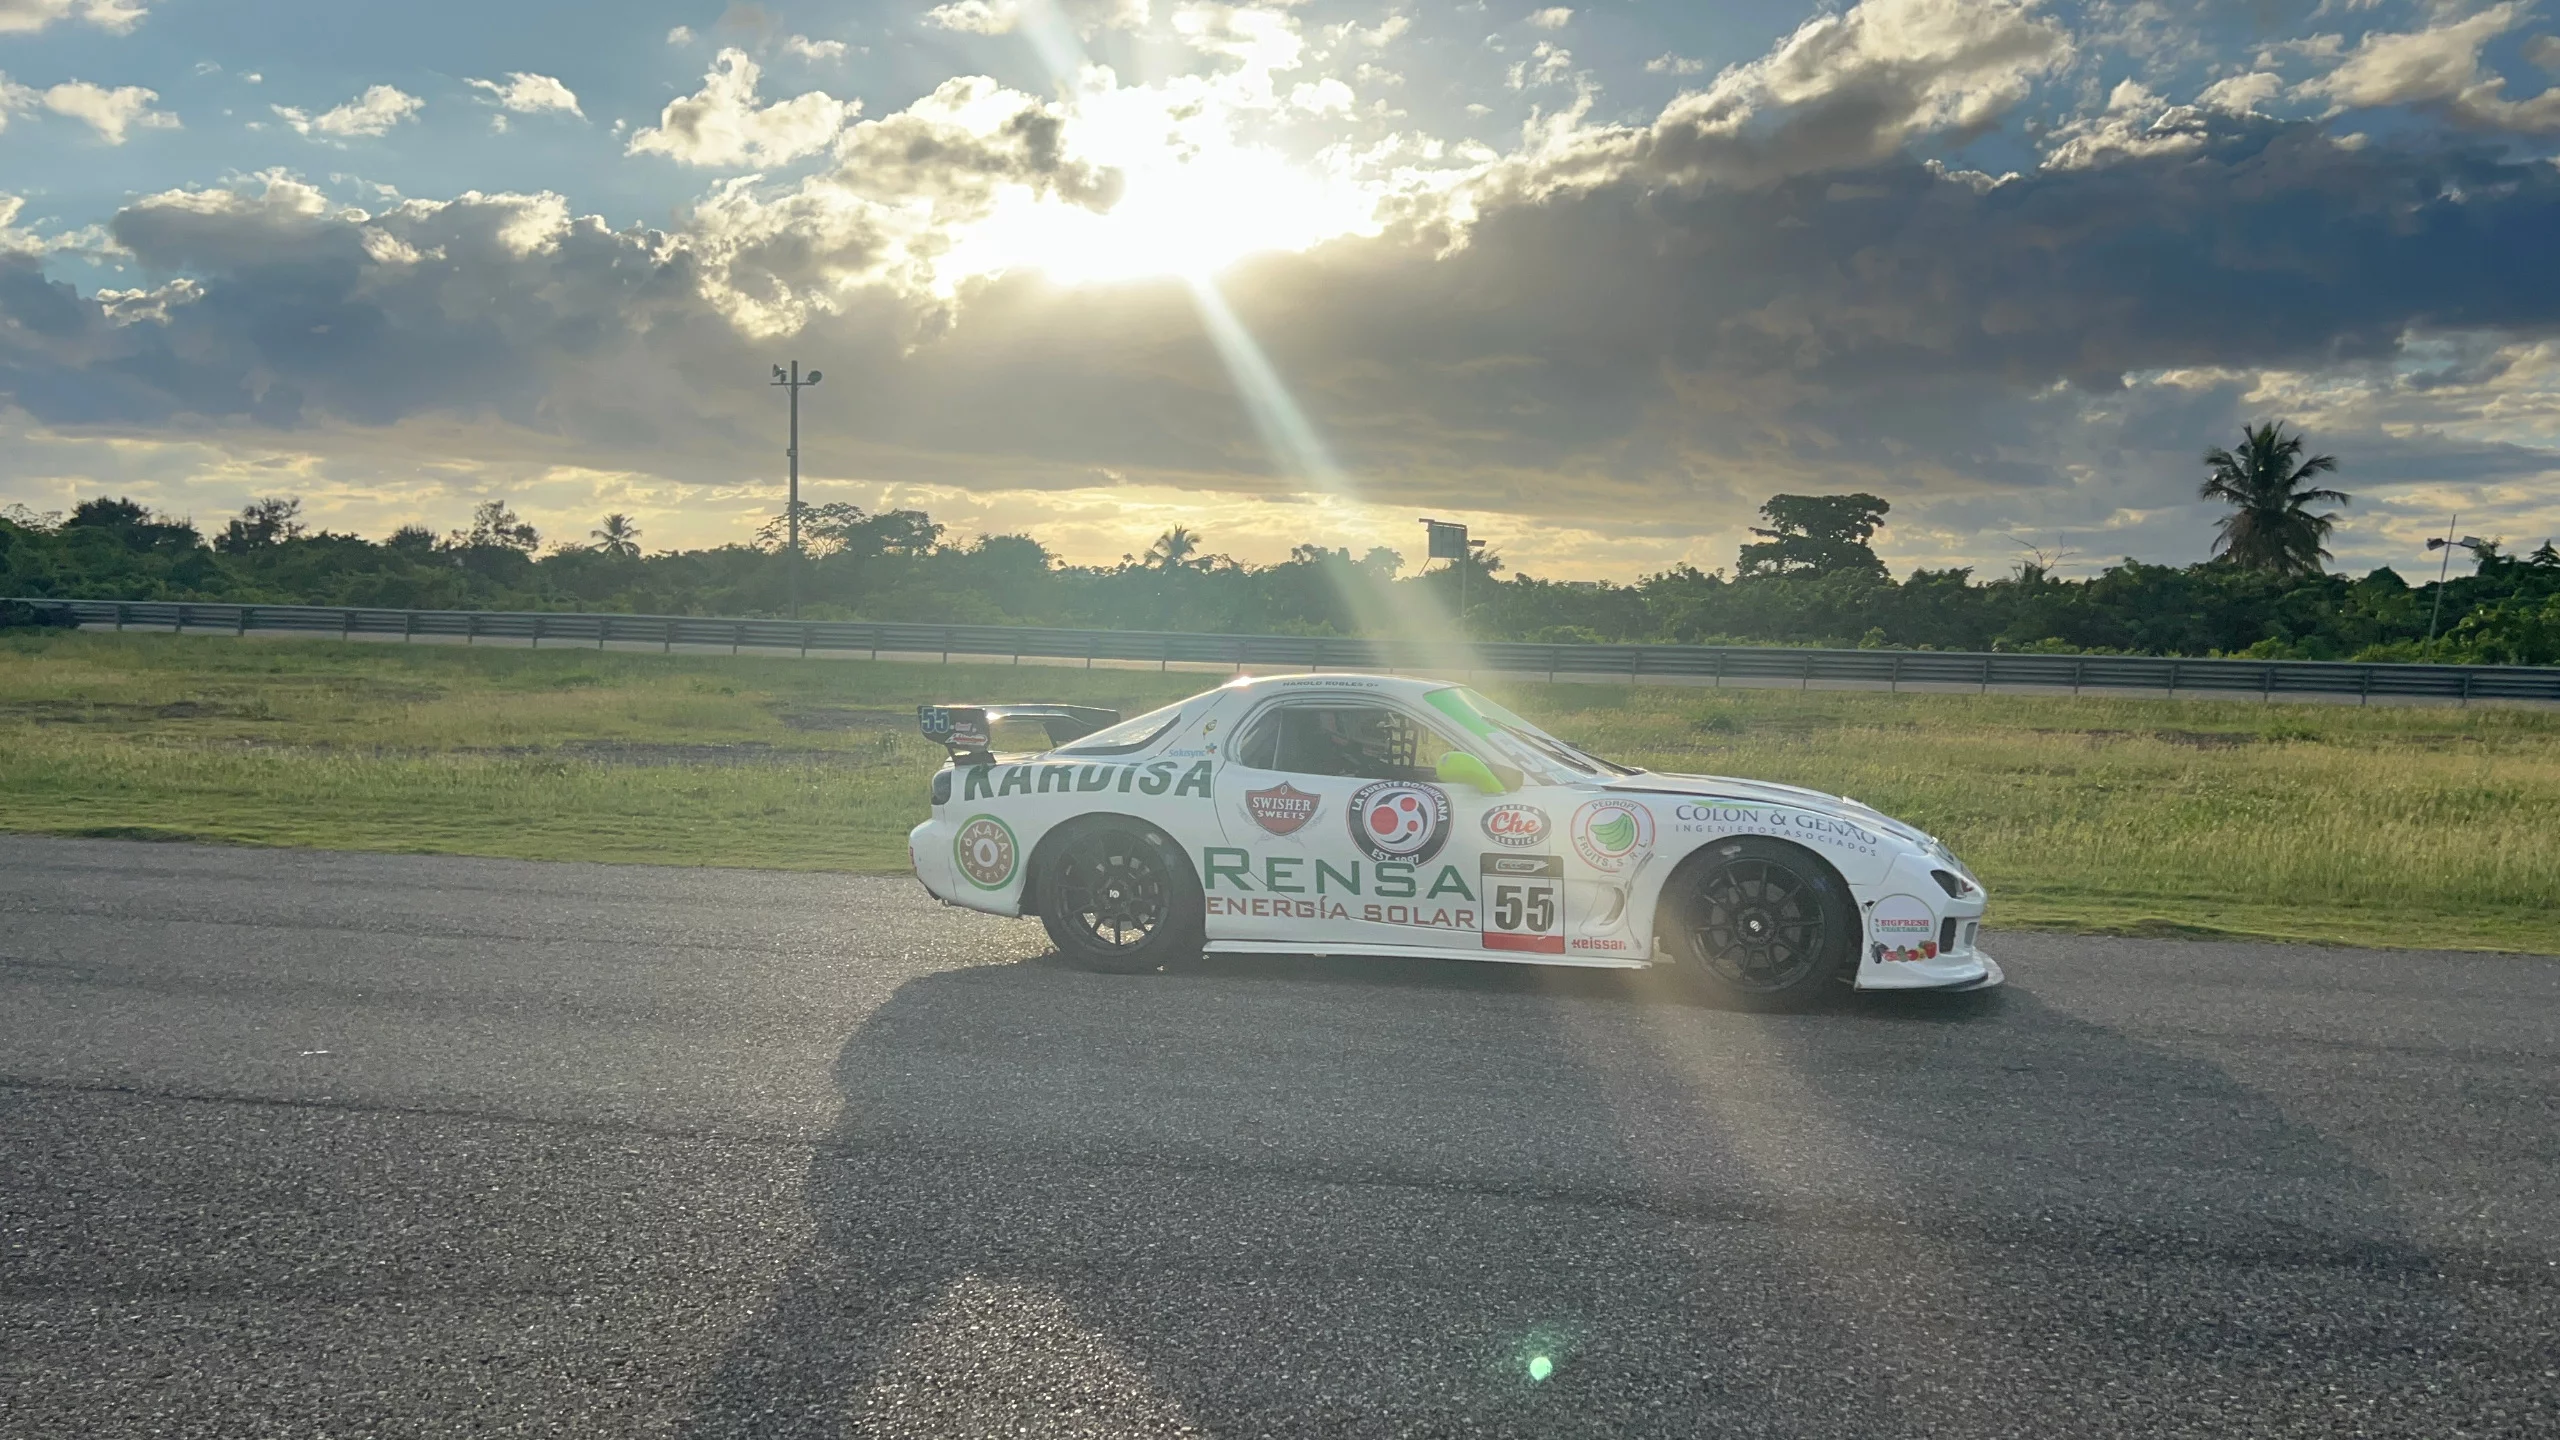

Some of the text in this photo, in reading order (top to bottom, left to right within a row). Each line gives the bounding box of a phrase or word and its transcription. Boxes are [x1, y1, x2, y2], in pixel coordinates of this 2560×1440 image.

[921, 706, 949, 734] 55
[964, 760, 1212, 801] KARDISA
[1252, 796, 1311, 812] SWISHER
[1257, 810, 1306, 820] SWEETS
[1352, 780, 1448, 822] LA SUERTE DOMINICANA
[1490, 811, 1541, 834] Che
[1770, 809, 1786, 826] &
[1495, 836, 1538, 845] SERVICE
[1676, 824, 1876, 856] INGENIEROS ASOCIADOS
[966, 861, 1008, 880] KEFIR
[1204, 846, 1477, 902] RENSA
[1206, 896, 1476, 928] ENERGÍA SOLAR
[1495, 885, 1554, 932] 55
